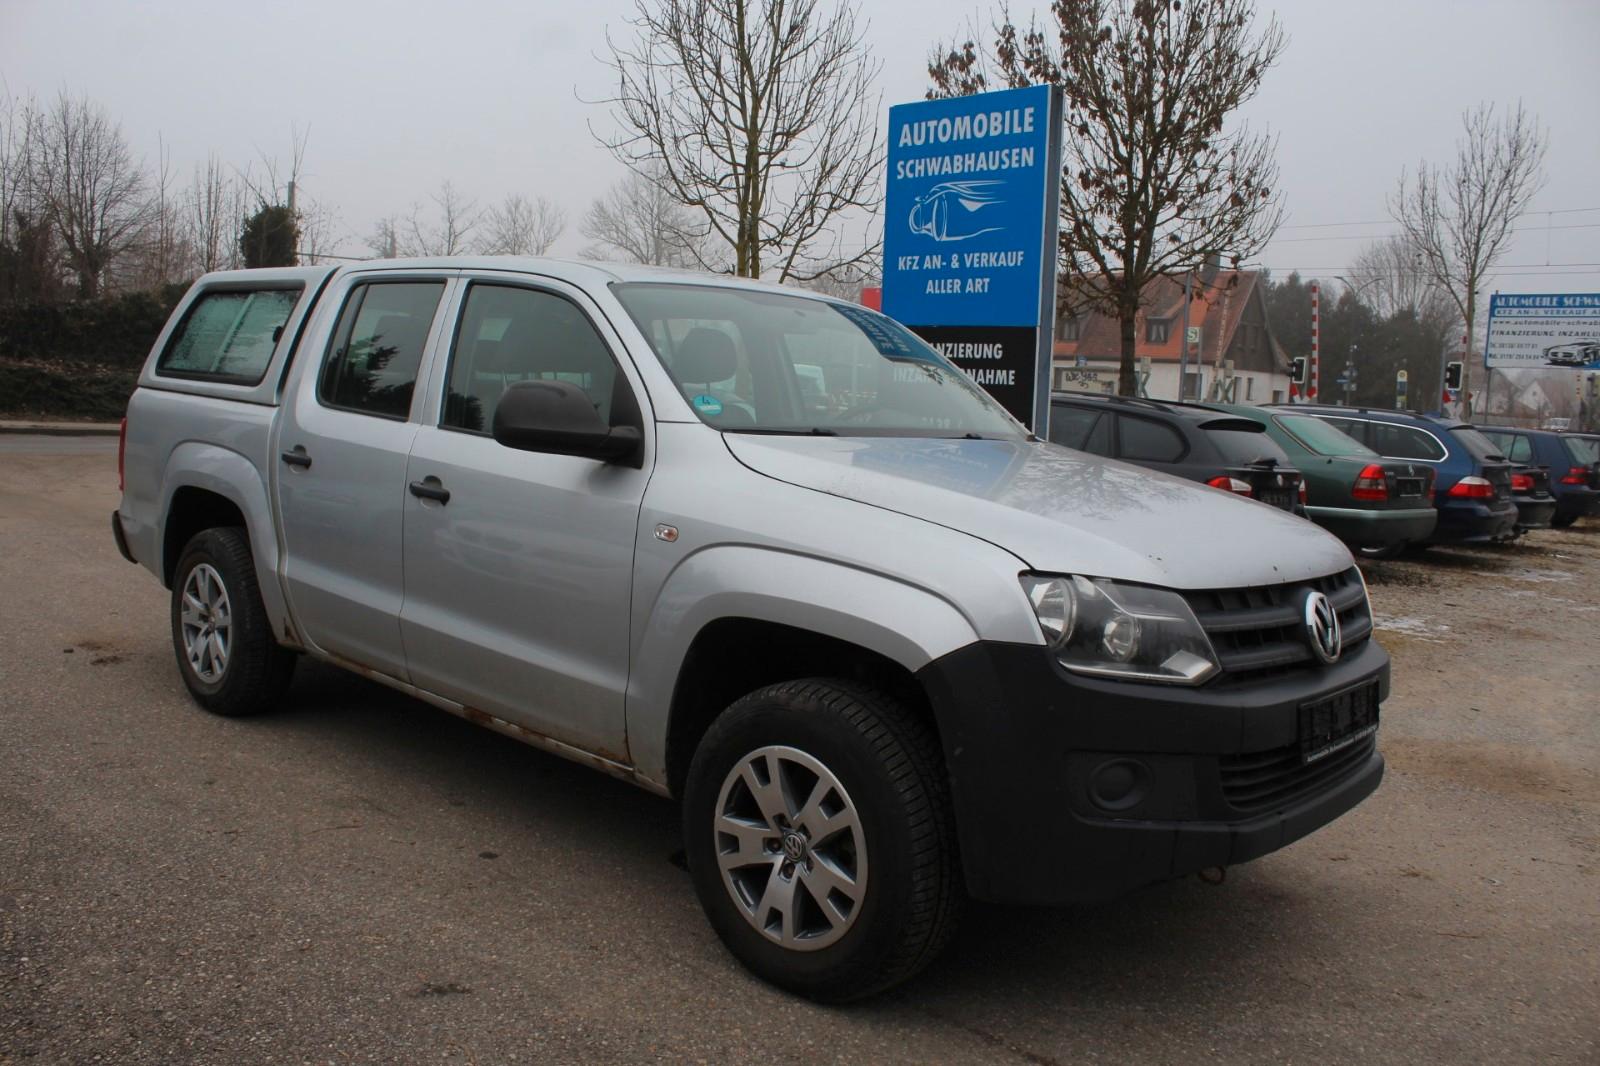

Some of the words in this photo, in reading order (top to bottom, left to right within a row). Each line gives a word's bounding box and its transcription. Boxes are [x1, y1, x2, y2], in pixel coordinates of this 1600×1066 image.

[898, 107, 1034, 147] AUTOMOBILE
[896, 146, 1034, 179] SCHWABHAUSEN
[898, 255, 919, 270] KFZ
[923, 255, 947, 269] AN-
[951, 254, 959, 269] &
[964, 251, 1024, 268] VERKAUF
[926, 279, 961, 294] ALLER
[965, 278, 990, 293] ART
